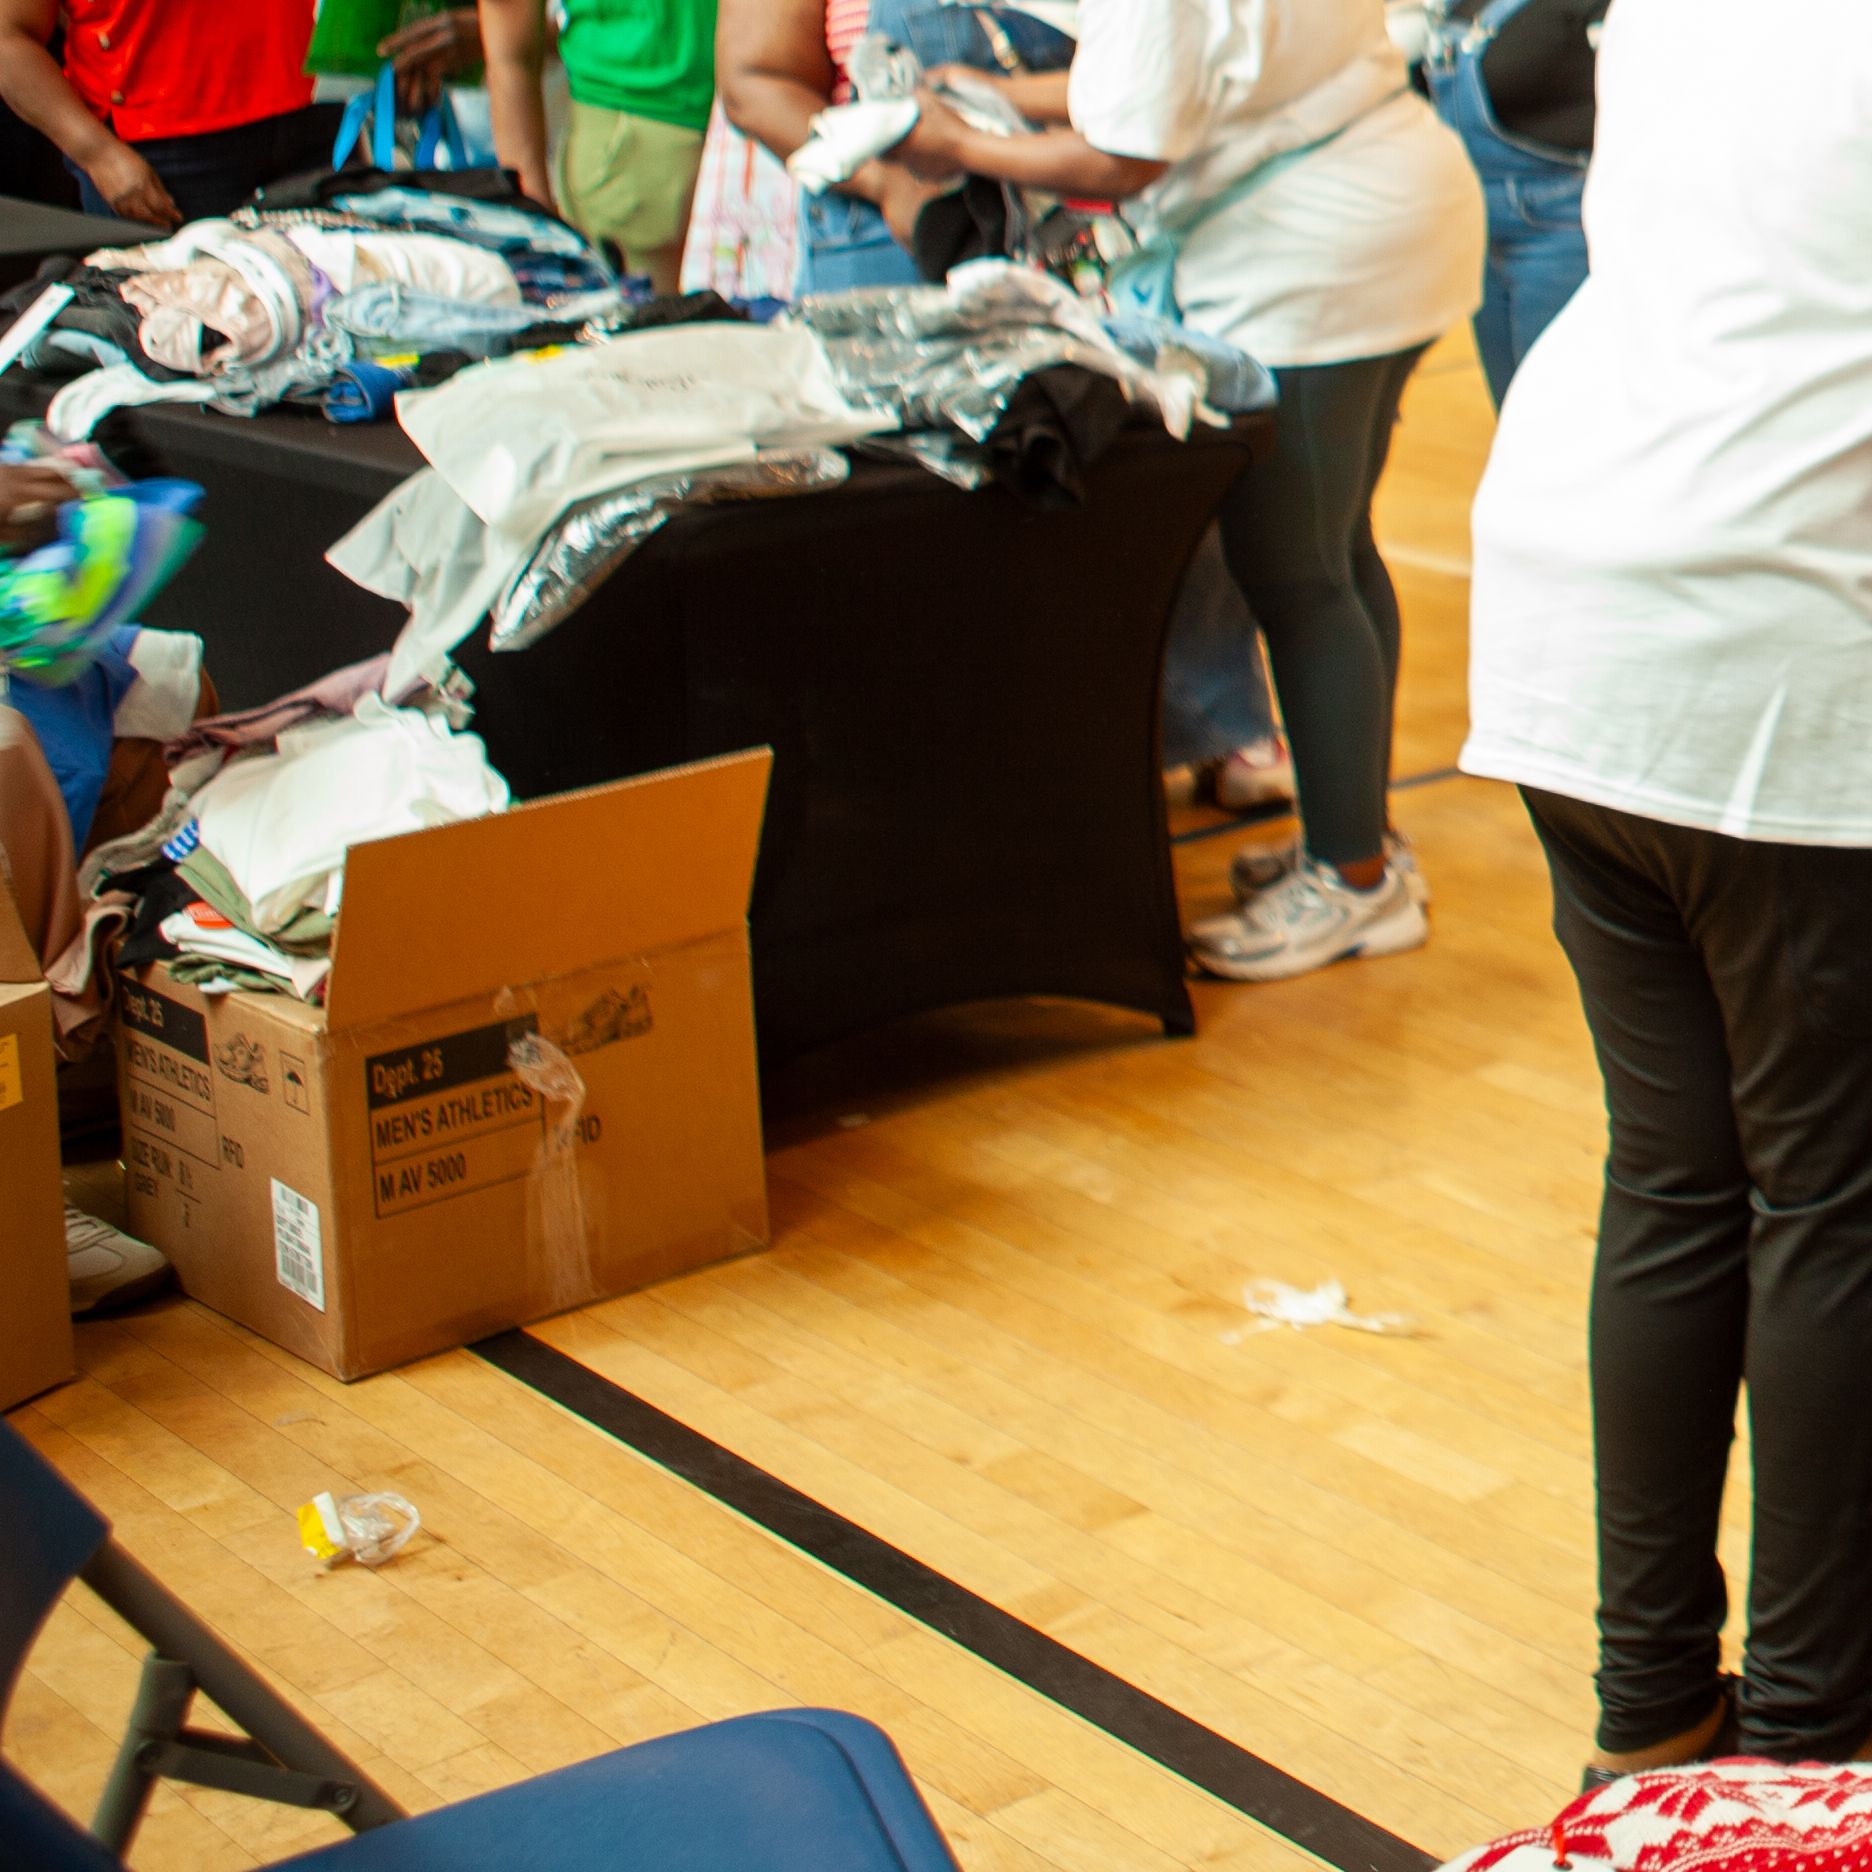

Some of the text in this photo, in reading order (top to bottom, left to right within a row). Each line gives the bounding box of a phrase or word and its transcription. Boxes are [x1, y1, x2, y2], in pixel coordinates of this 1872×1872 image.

[372, 1047, 445, 1099] Dept. 25
[376, 1082, 533, 1149] MEN'S ATHLETICS
[379, 1152, 467, 1203] M AV 5000
